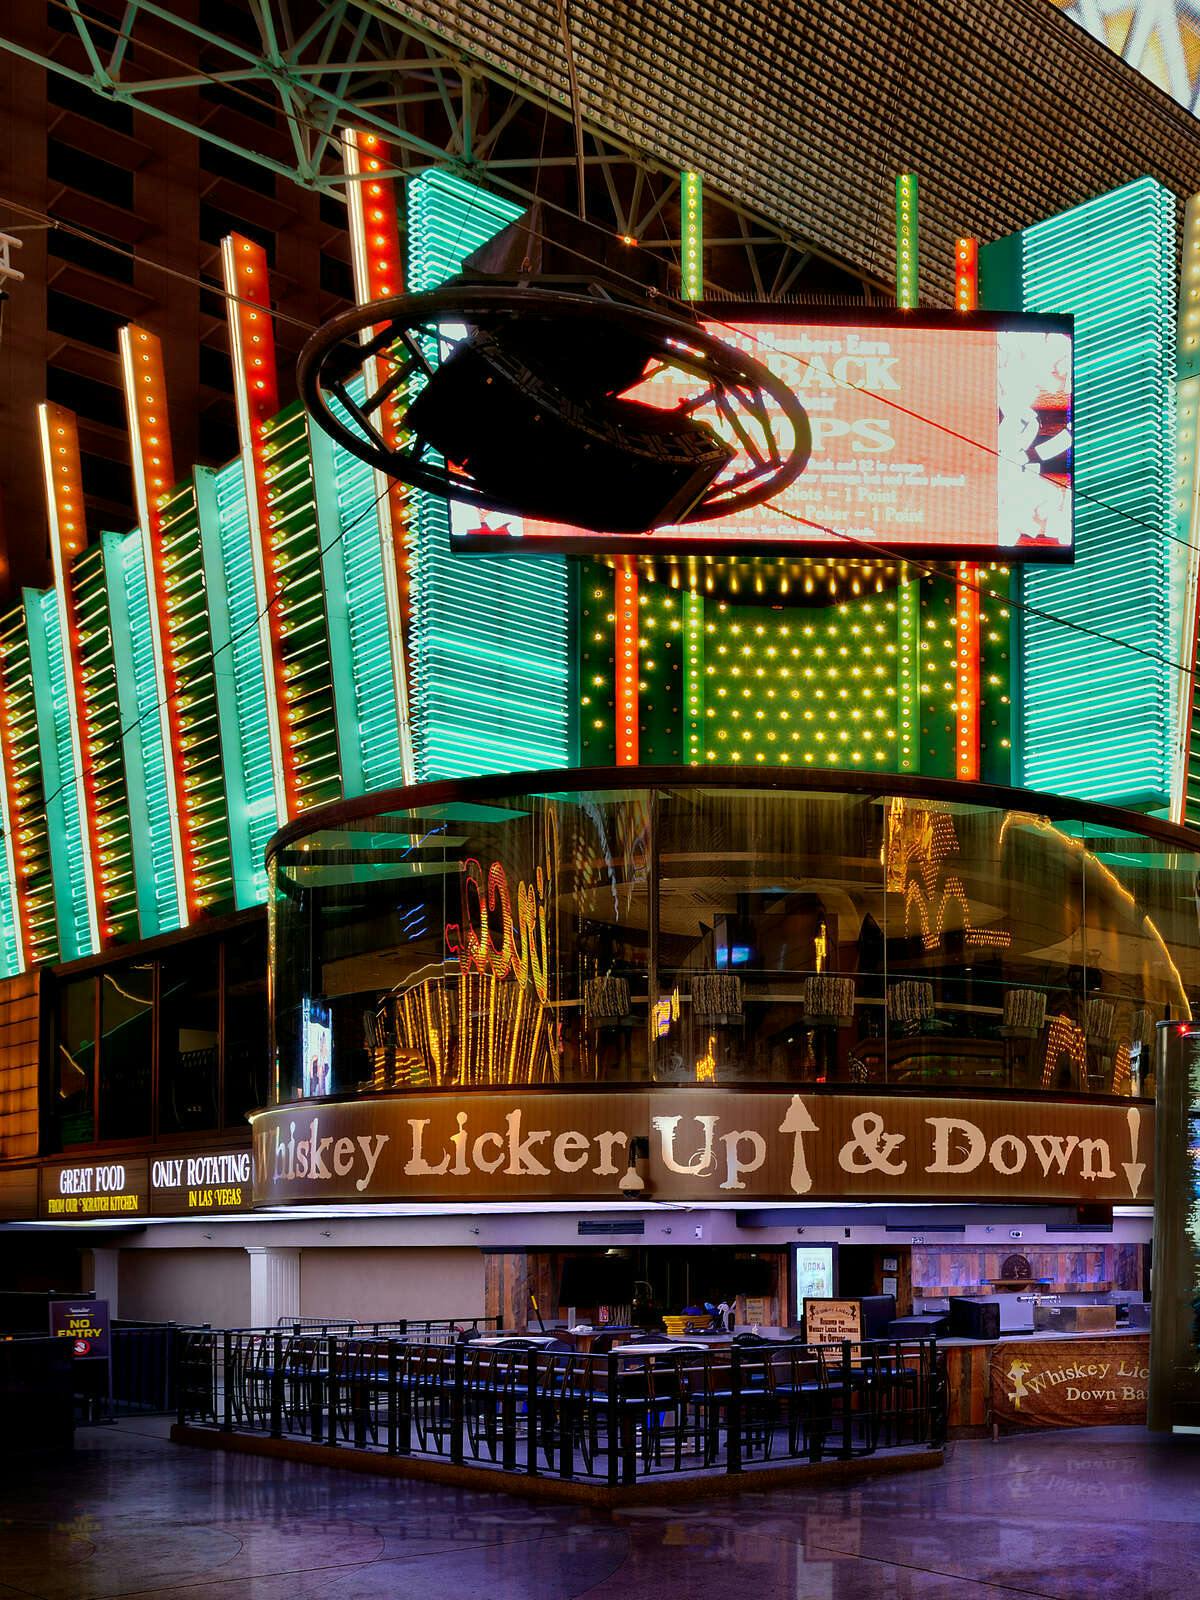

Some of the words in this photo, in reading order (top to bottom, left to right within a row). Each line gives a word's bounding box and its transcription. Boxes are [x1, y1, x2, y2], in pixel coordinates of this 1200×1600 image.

[766, 354, 901, 390] BACK
[403, 1108, 628, 1177] Licker
[652, 1114, 767, 1190] Up
[838, 1111, 907, 1176] &
[924, 1116, 1117, 1182] Down
[59, 1167, 93, 1194] GREAT
[95, 1165, 126, 1192] FOOD
[152, 1158, 185, 1188] ONLY
[187, 1153, 251, 1186] ROTATING
[48, 1199, 65, 1213] FROM
[65, 1198, 77, 1213] OUR
[79, 1196, 109, 1212] SCRATCH
[110, 1195, 139, 1211] KITCHEN
[188, 1189, 198, 1207] IN
[198, 1190, 213, 1207] LAS
[214, 1188, 242, 1206] VEGAS
[57, 1328, 103, 1338] ENTRY
[70, 1319, 90, 1328] NO
[1025, 1360, 1111, 1394] Whiskey
[1065, 1387, 1117, 1401] Down
